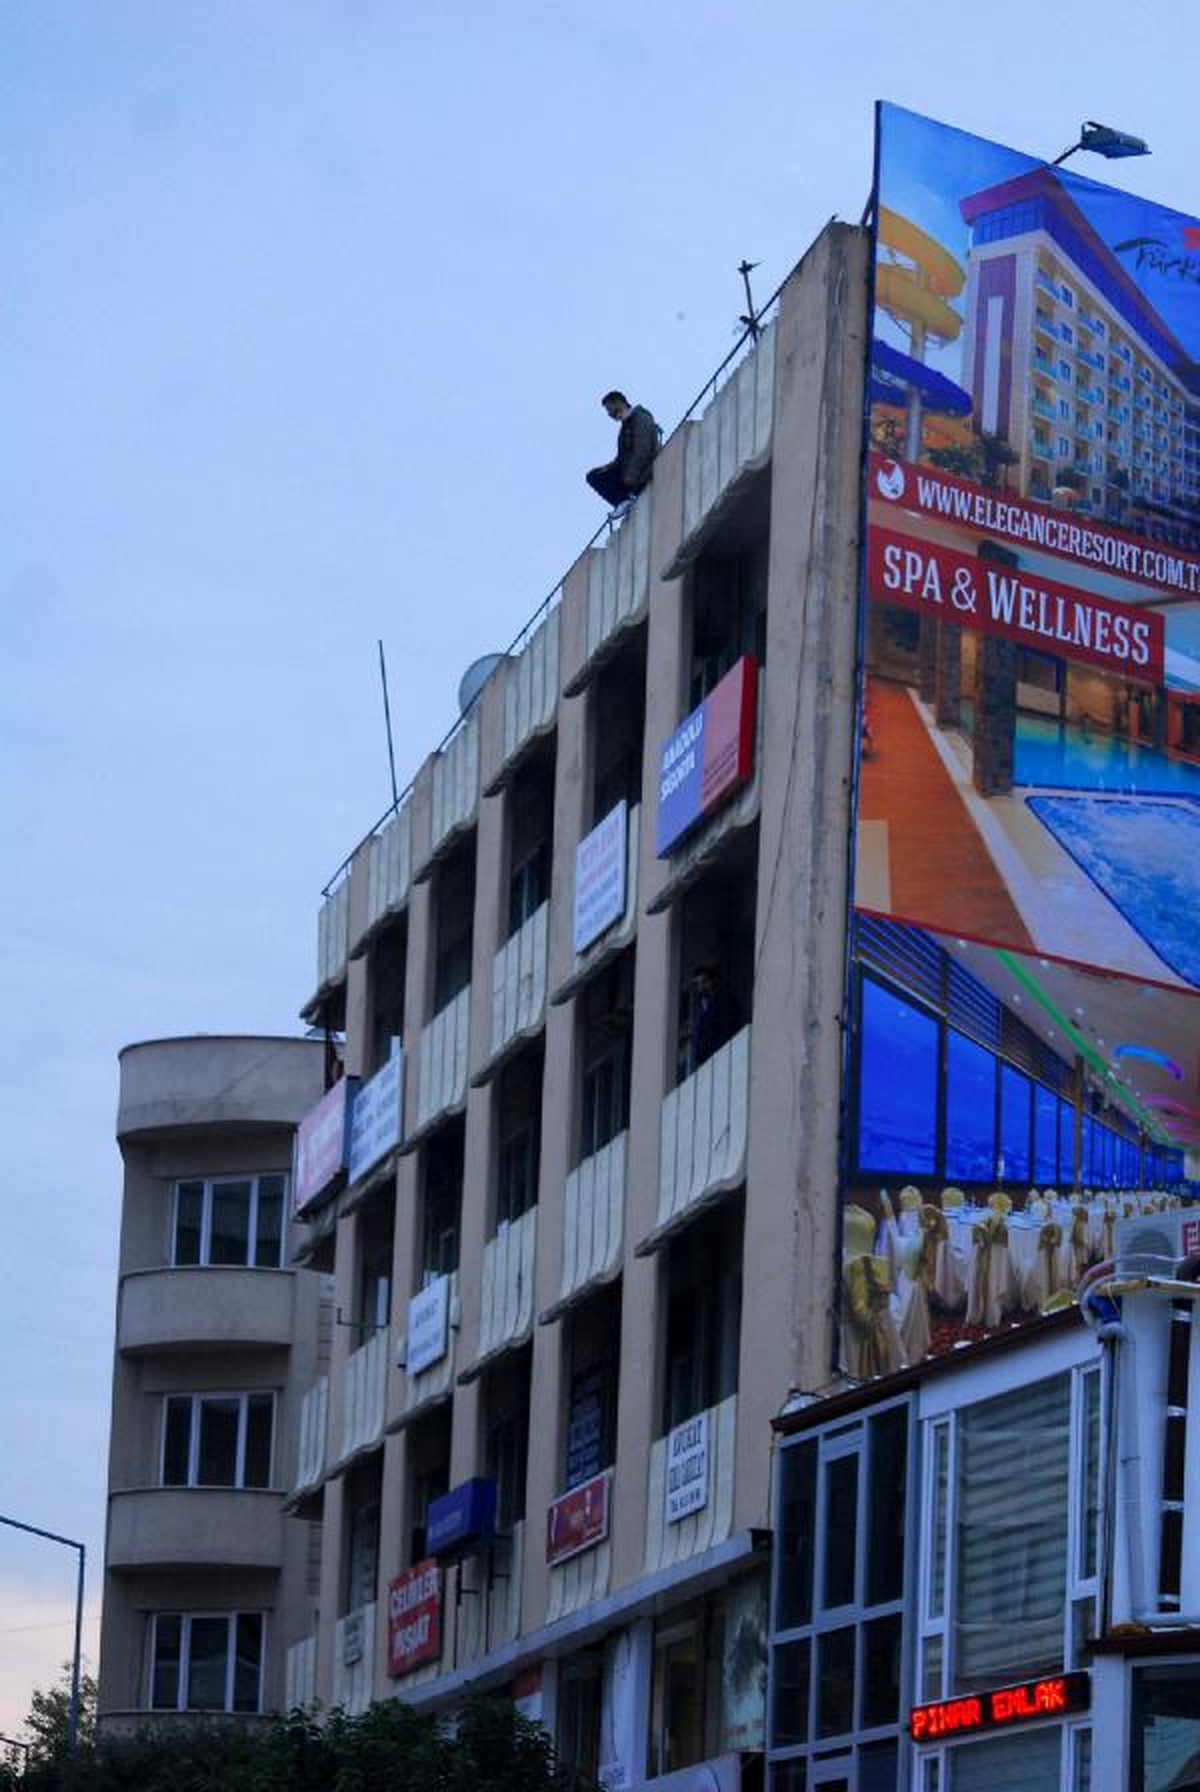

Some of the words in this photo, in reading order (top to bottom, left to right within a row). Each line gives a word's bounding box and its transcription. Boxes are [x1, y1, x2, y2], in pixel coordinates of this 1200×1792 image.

[917, 476, 1200, 593] WWW.ELEGANCERESORT.COM.T
[884, 545, 943, 603] SPA
[951, 567, 977, 613] &
[987, 571, 1149, 665] WELLNESS
[912, 1697, 981, 1739] PINAR
[991, 1679, 1065, 1721] EMLAK
